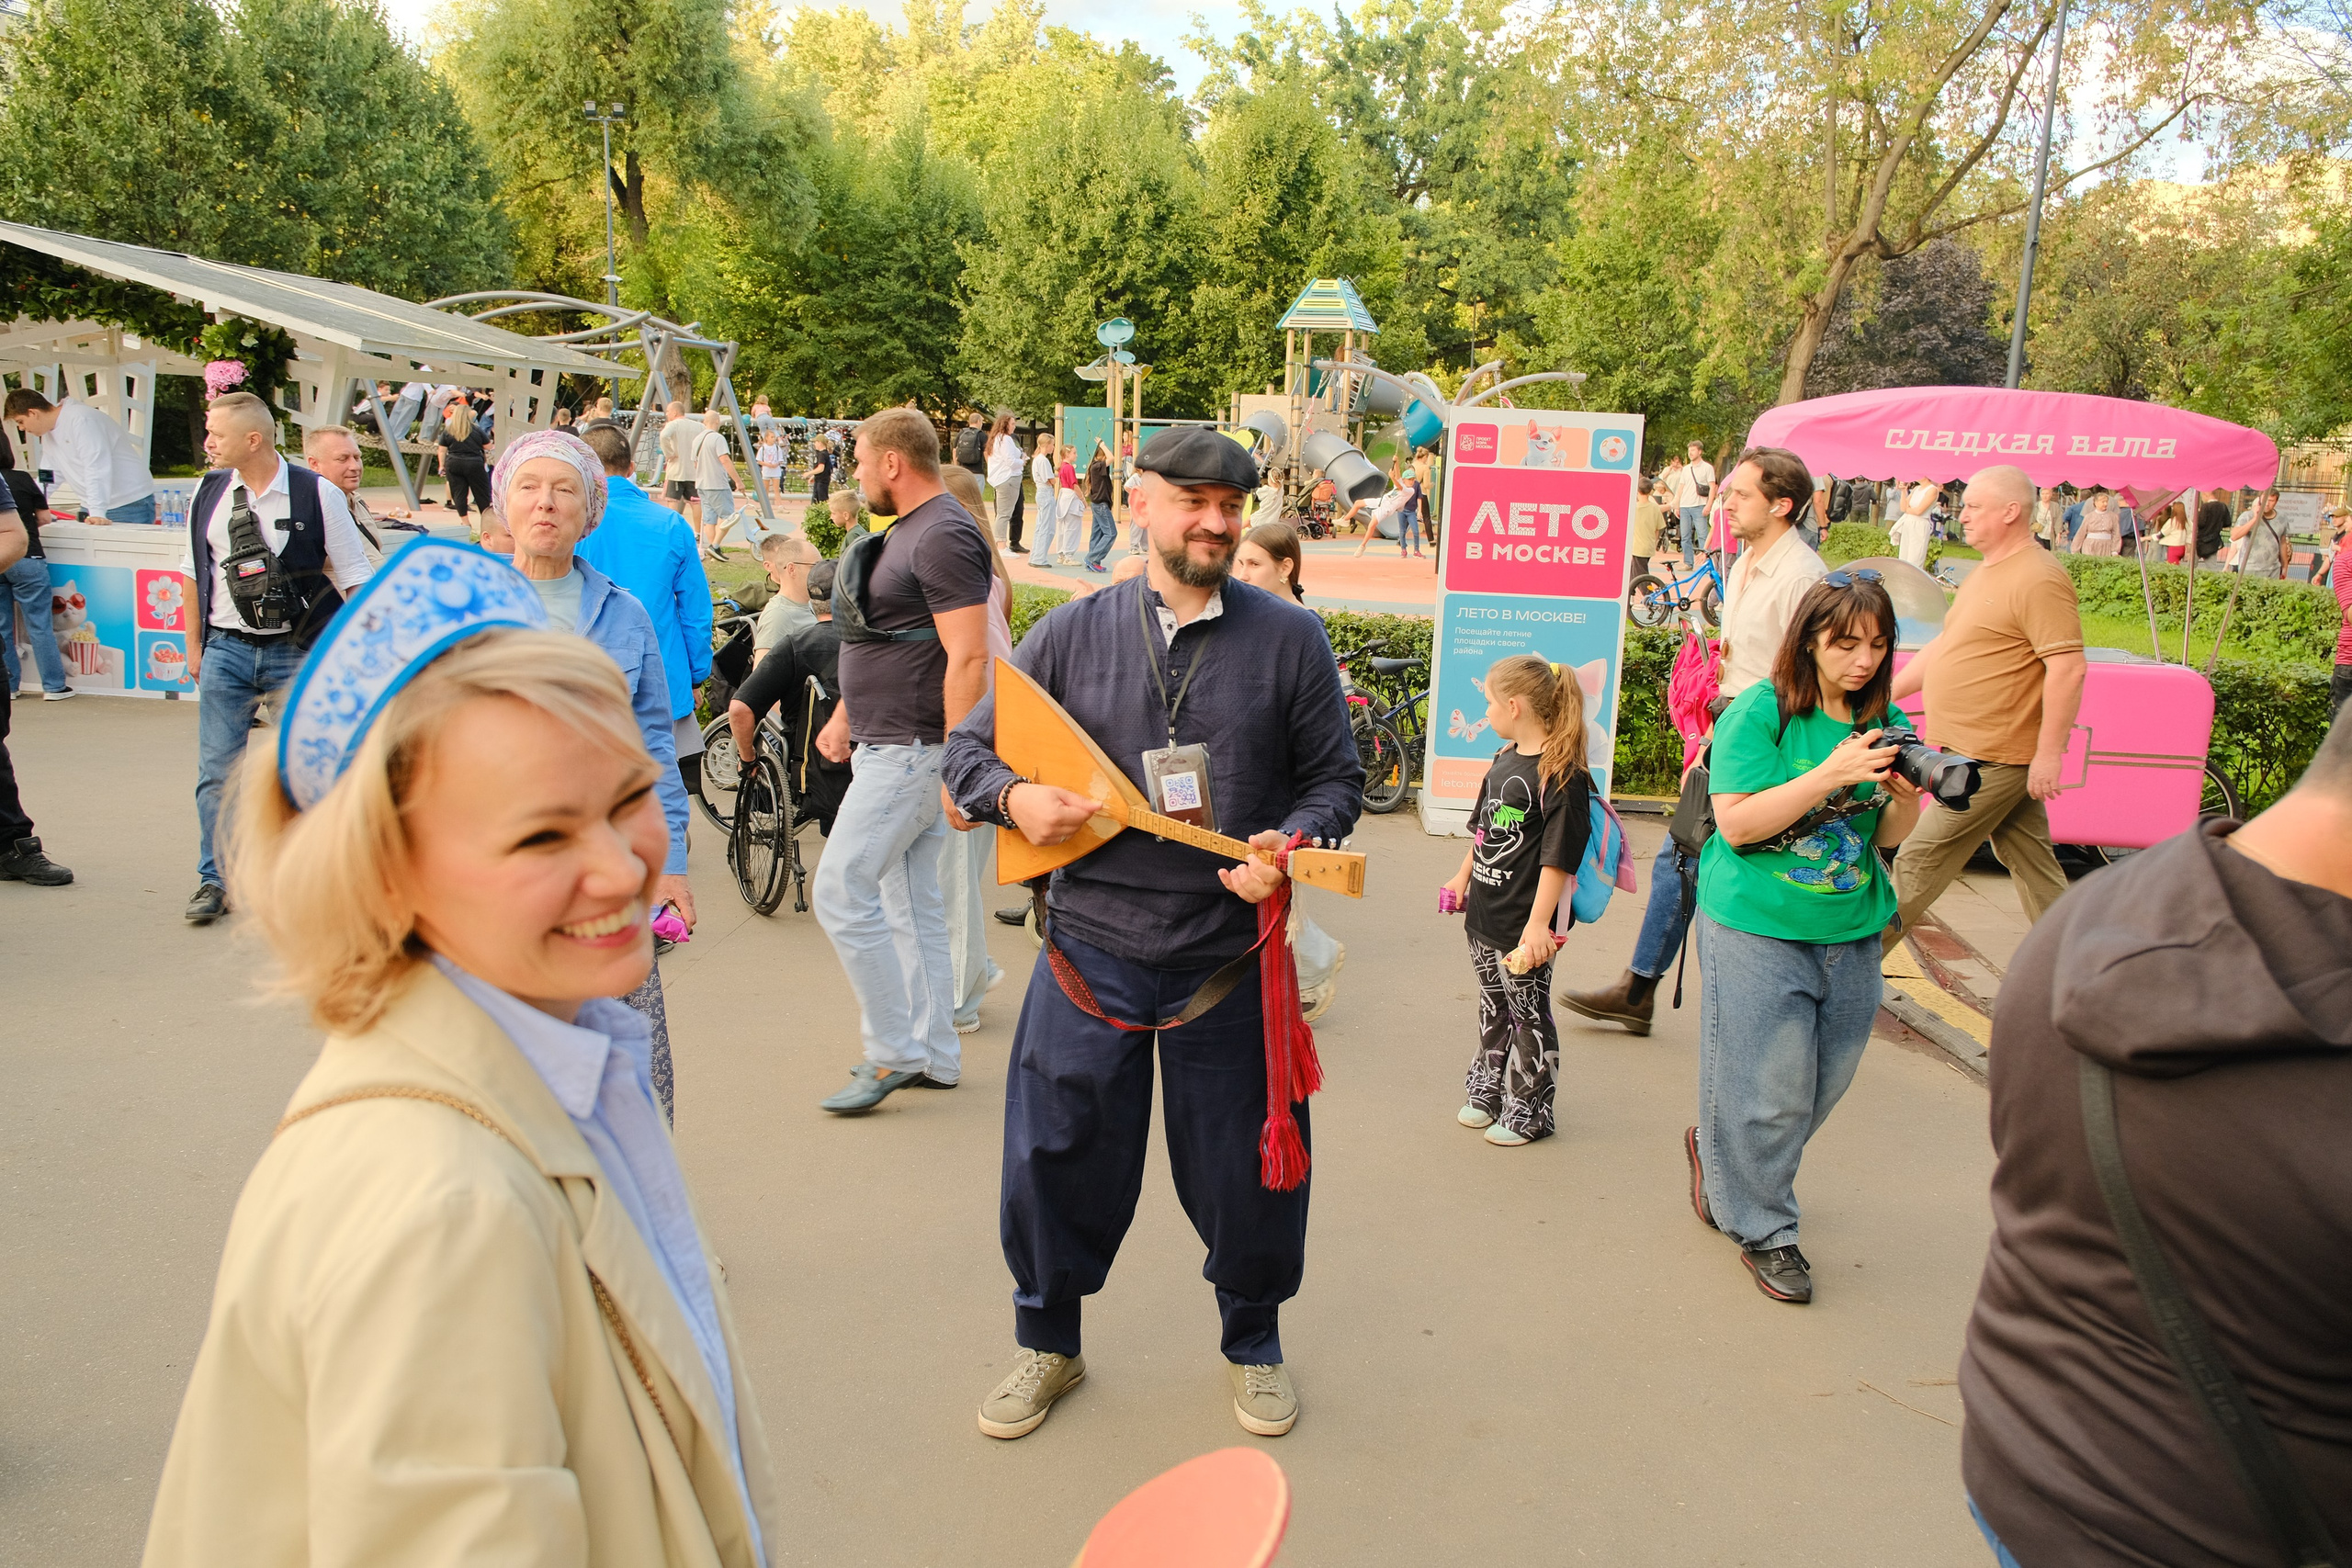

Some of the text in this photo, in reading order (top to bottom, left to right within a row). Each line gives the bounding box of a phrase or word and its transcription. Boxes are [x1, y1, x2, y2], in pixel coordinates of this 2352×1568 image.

[1884, 428, 2177, 458] сладкая вата
[1467, 501, 1610, 540] ЛЕТО
[1465, 542, 1607, 566] В МОСКВЕ
[1456, 607, 1587, 624] ЛЕТО В МОСКВЕ!
[1454, 626, 1501, 637] Посещайте
[1453, 637, 1496, 647] площадки
[1453, 647, 1483, 655] района
[1472, 860, 1514, 880] ICKEY
